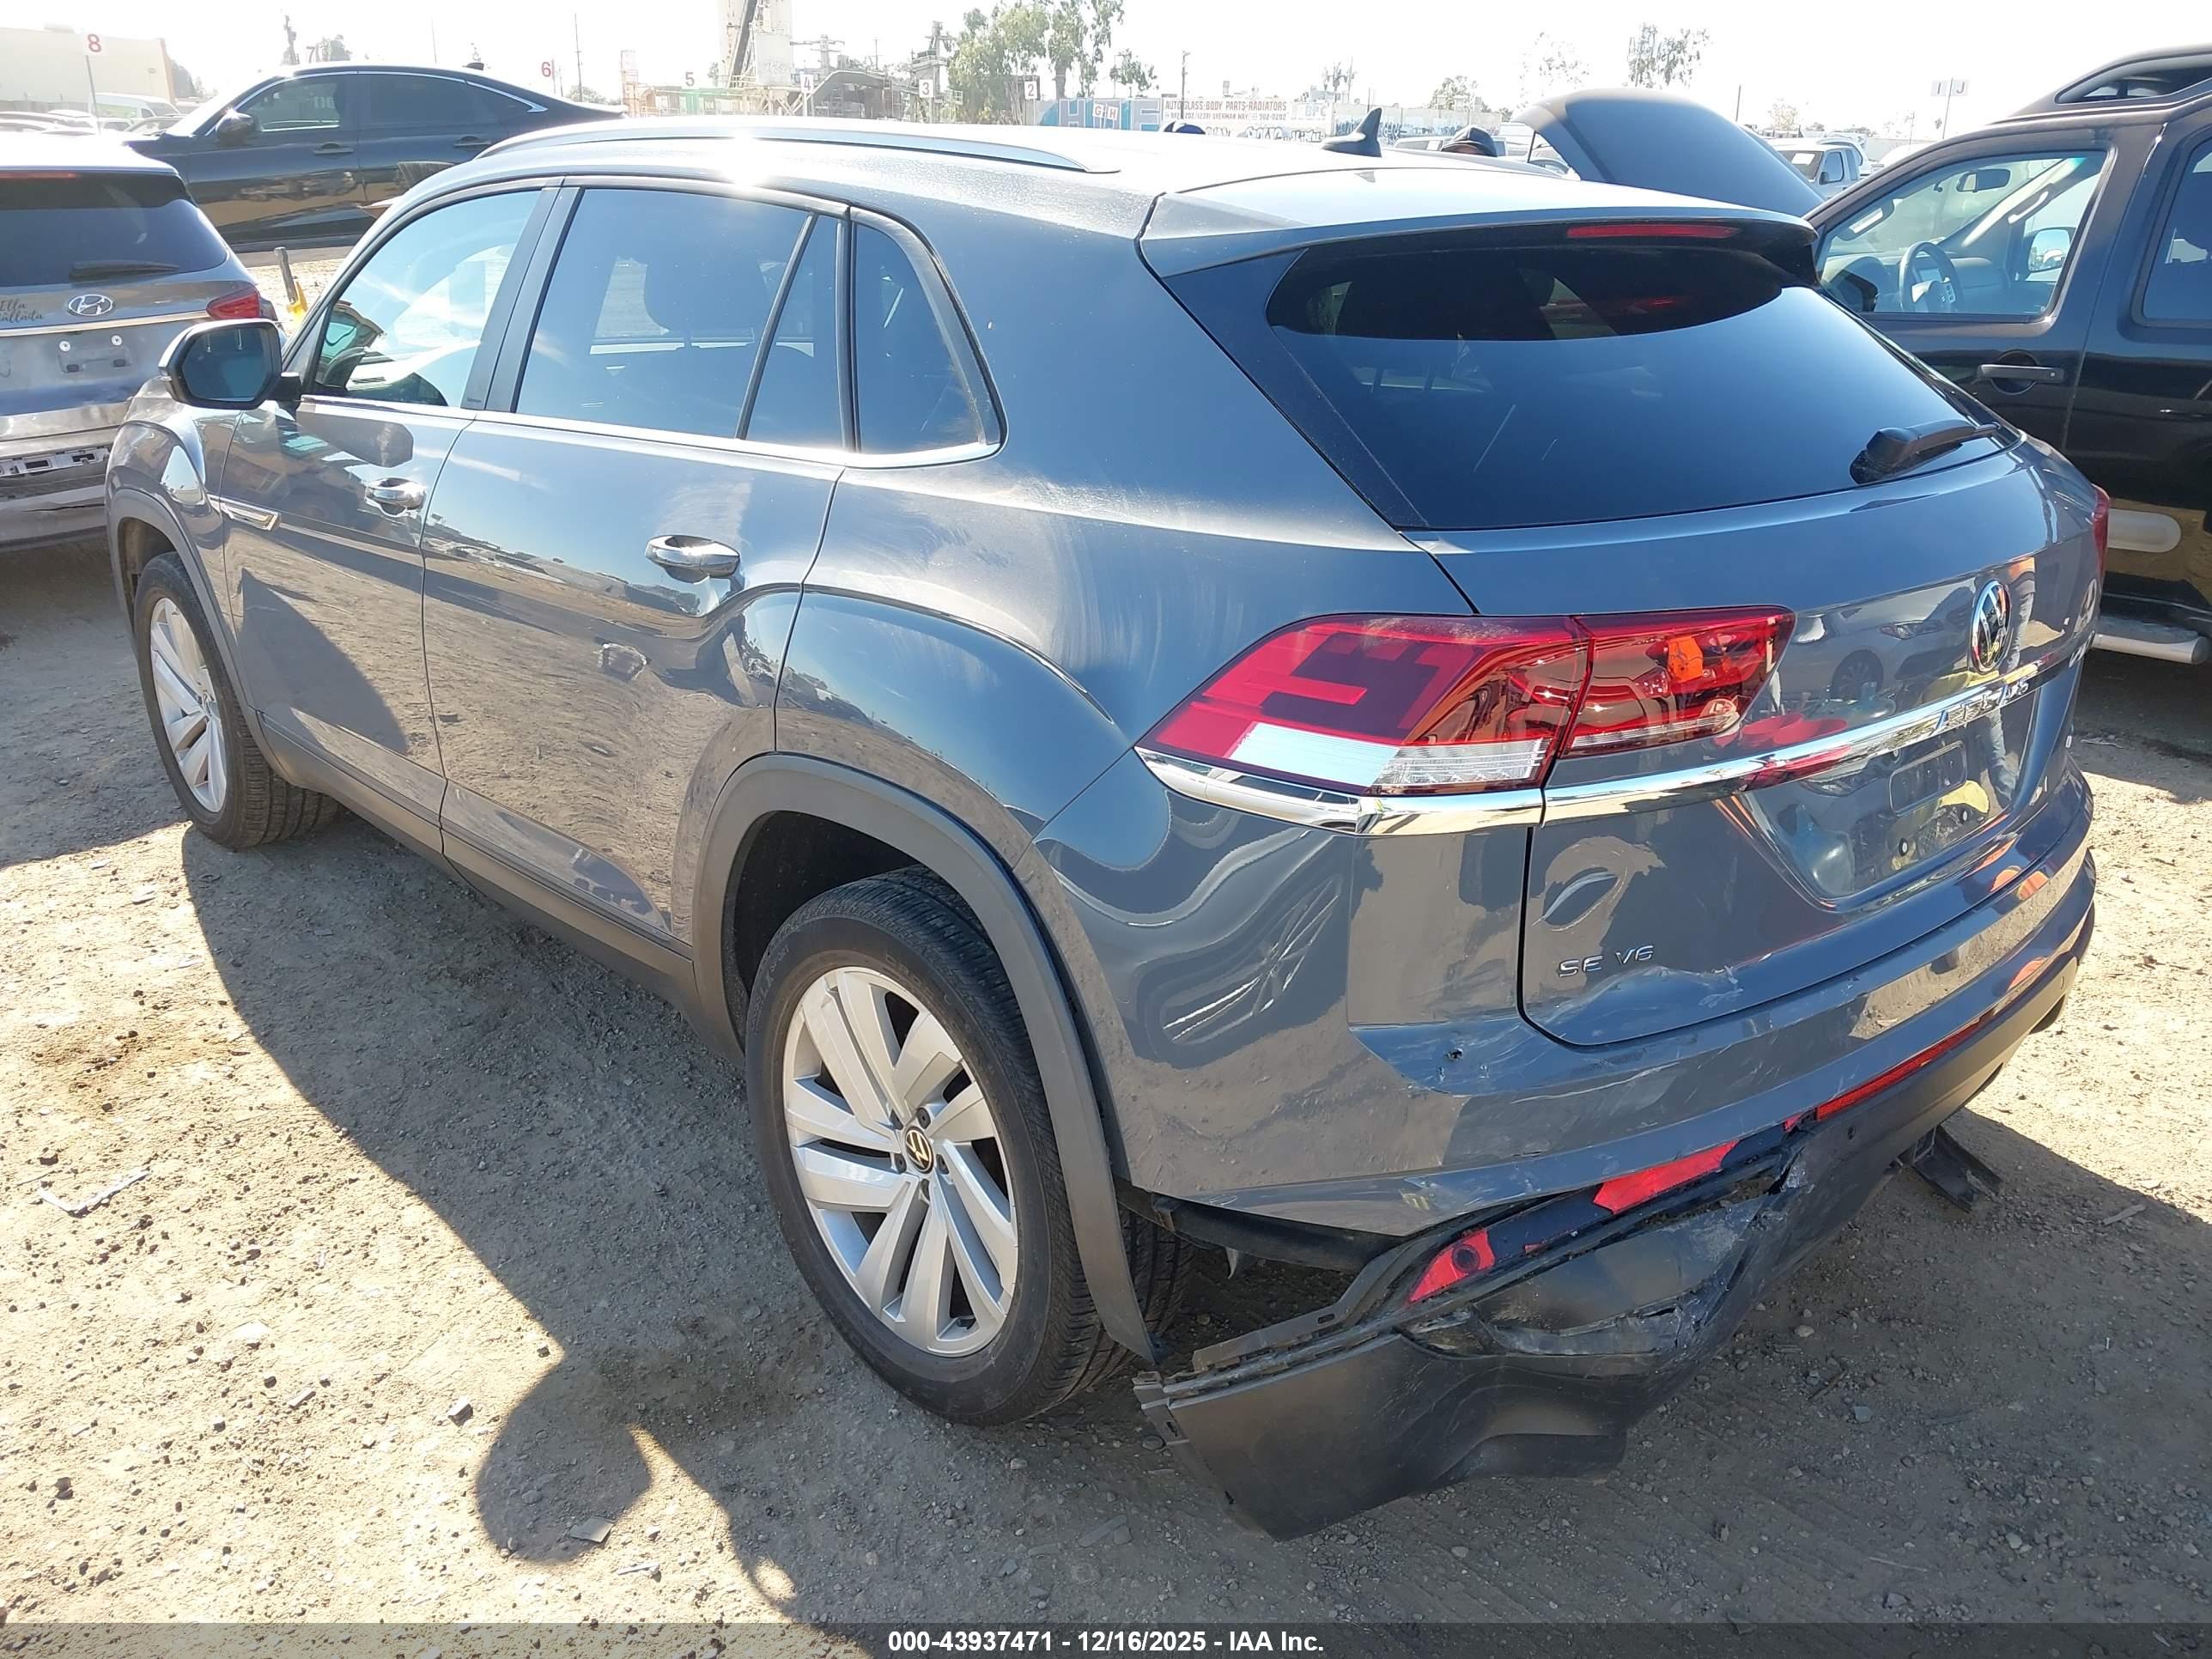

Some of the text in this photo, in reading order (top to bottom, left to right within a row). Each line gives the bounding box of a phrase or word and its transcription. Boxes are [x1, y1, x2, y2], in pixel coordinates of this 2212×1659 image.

[87, 33, 103, 53] 8
[306, 46, 316, 64] 7
[541, 61, 552, 78] 6
[684, 70, 695, 88] 5
[803, 76, 811, 92] 4
[921, 82, 930, 96] 3
[1027, 83, 1035, 97] 2
[1955, 82, 1966, 94] J
[1094, 104, 1103, 116] G
[1107, 108, 1117, 119] H
[1558, 944, 1655, 979] SE V6
